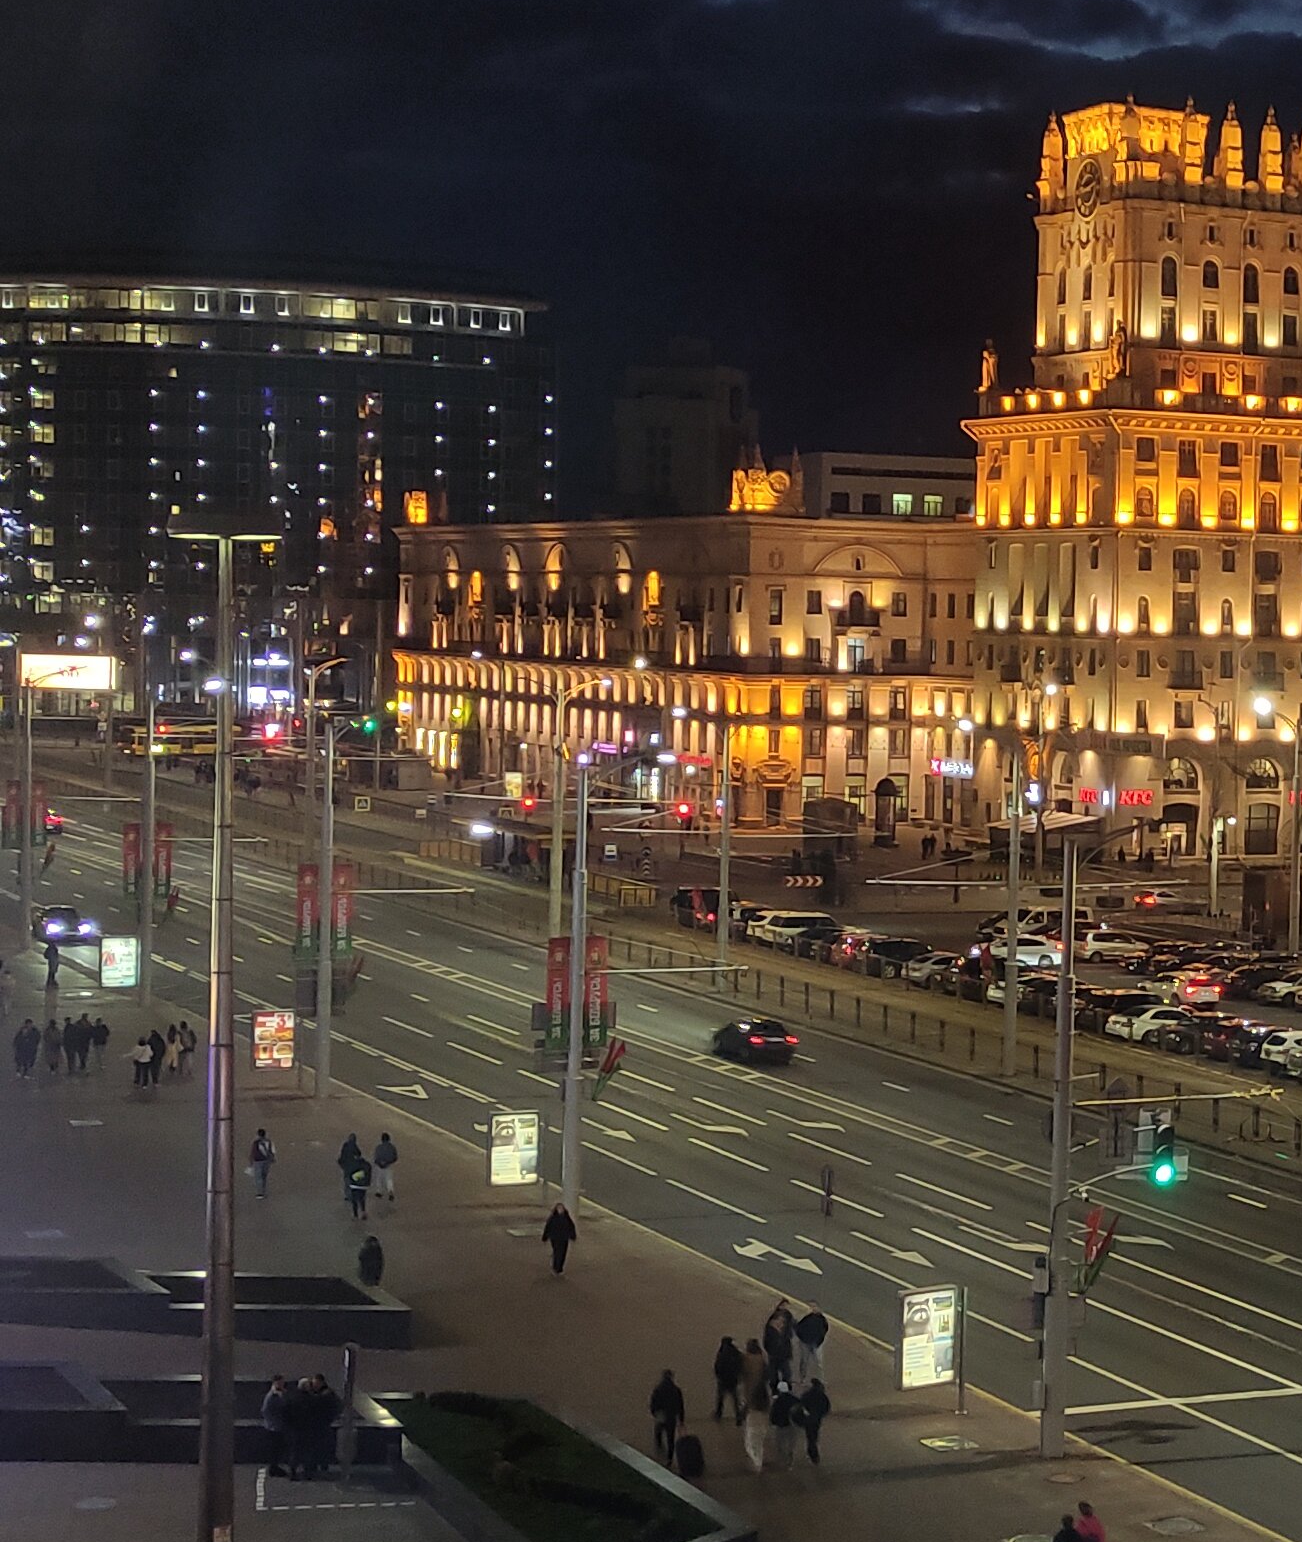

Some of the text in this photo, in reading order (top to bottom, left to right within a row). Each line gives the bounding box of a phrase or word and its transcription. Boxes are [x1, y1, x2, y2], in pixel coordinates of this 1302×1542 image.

[1079, 787, 1097, 803] KFC
[1120, 790, 1153, 806] KFC
[589, 1028, 600, 1042] ЗА
